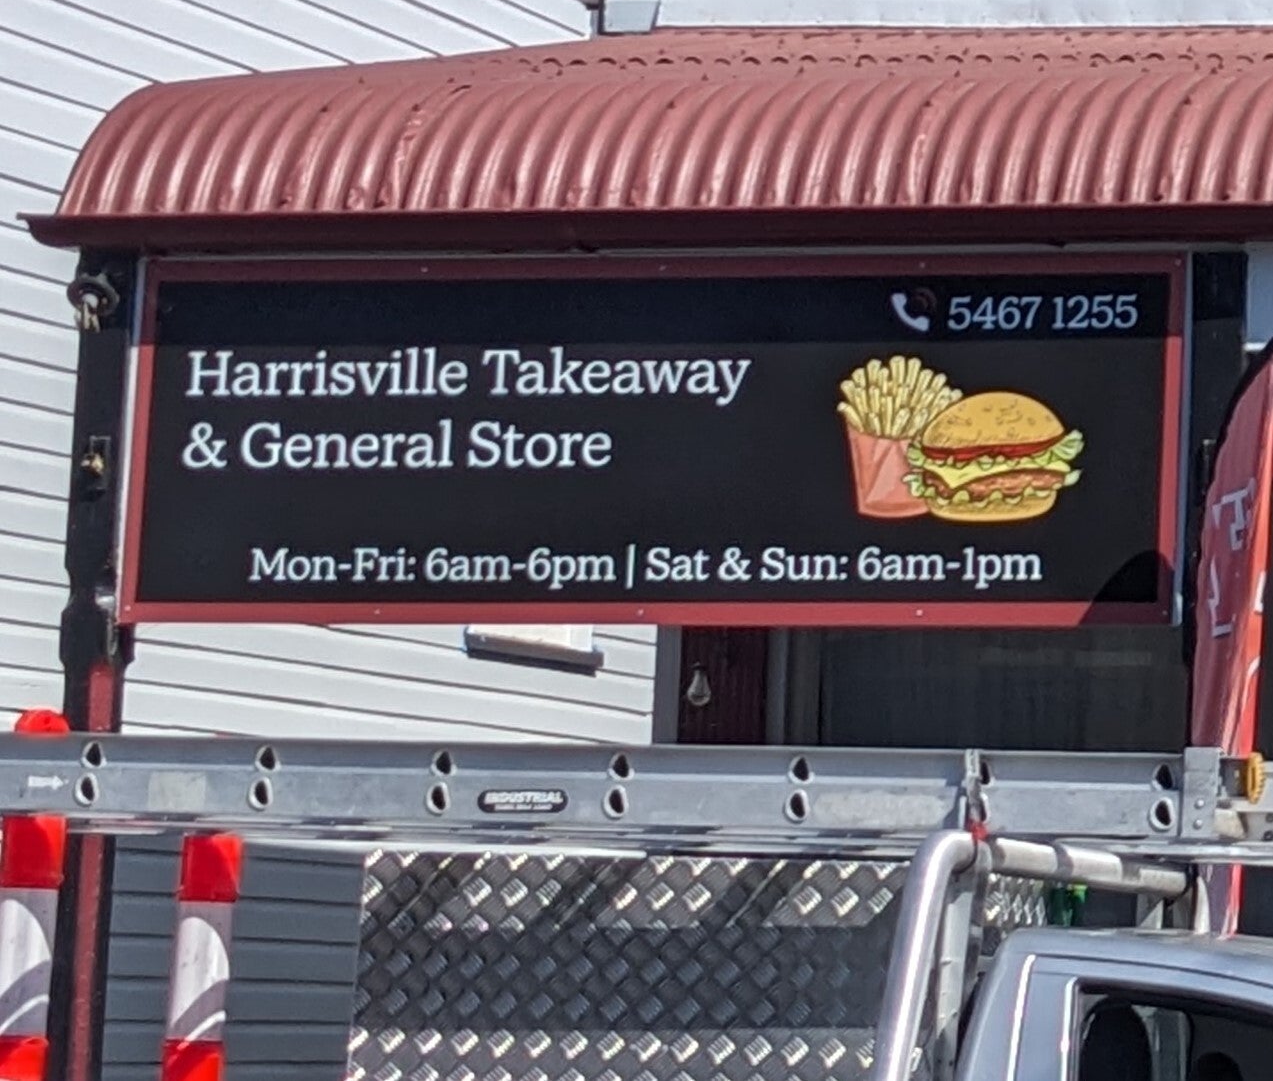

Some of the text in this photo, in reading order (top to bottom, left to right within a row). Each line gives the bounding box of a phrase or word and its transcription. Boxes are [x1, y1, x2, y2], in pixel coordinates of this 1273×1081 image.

[948, 295, 1137, 329] 5467 1255
[186, 347, 750, 405] Harrisville Takeaway
[183, 419, 611, 468] & General Store
[250, 548, 415, 581] Mon-Fri:
[425, 548, 616, 589] 6am-6pm
[646, 548, 709, 581] Sat
[718, 548, 751, 580] &
[761, 547, 848, 580] Sun:
[858, 547, 1042, 589] 6am-1pm
